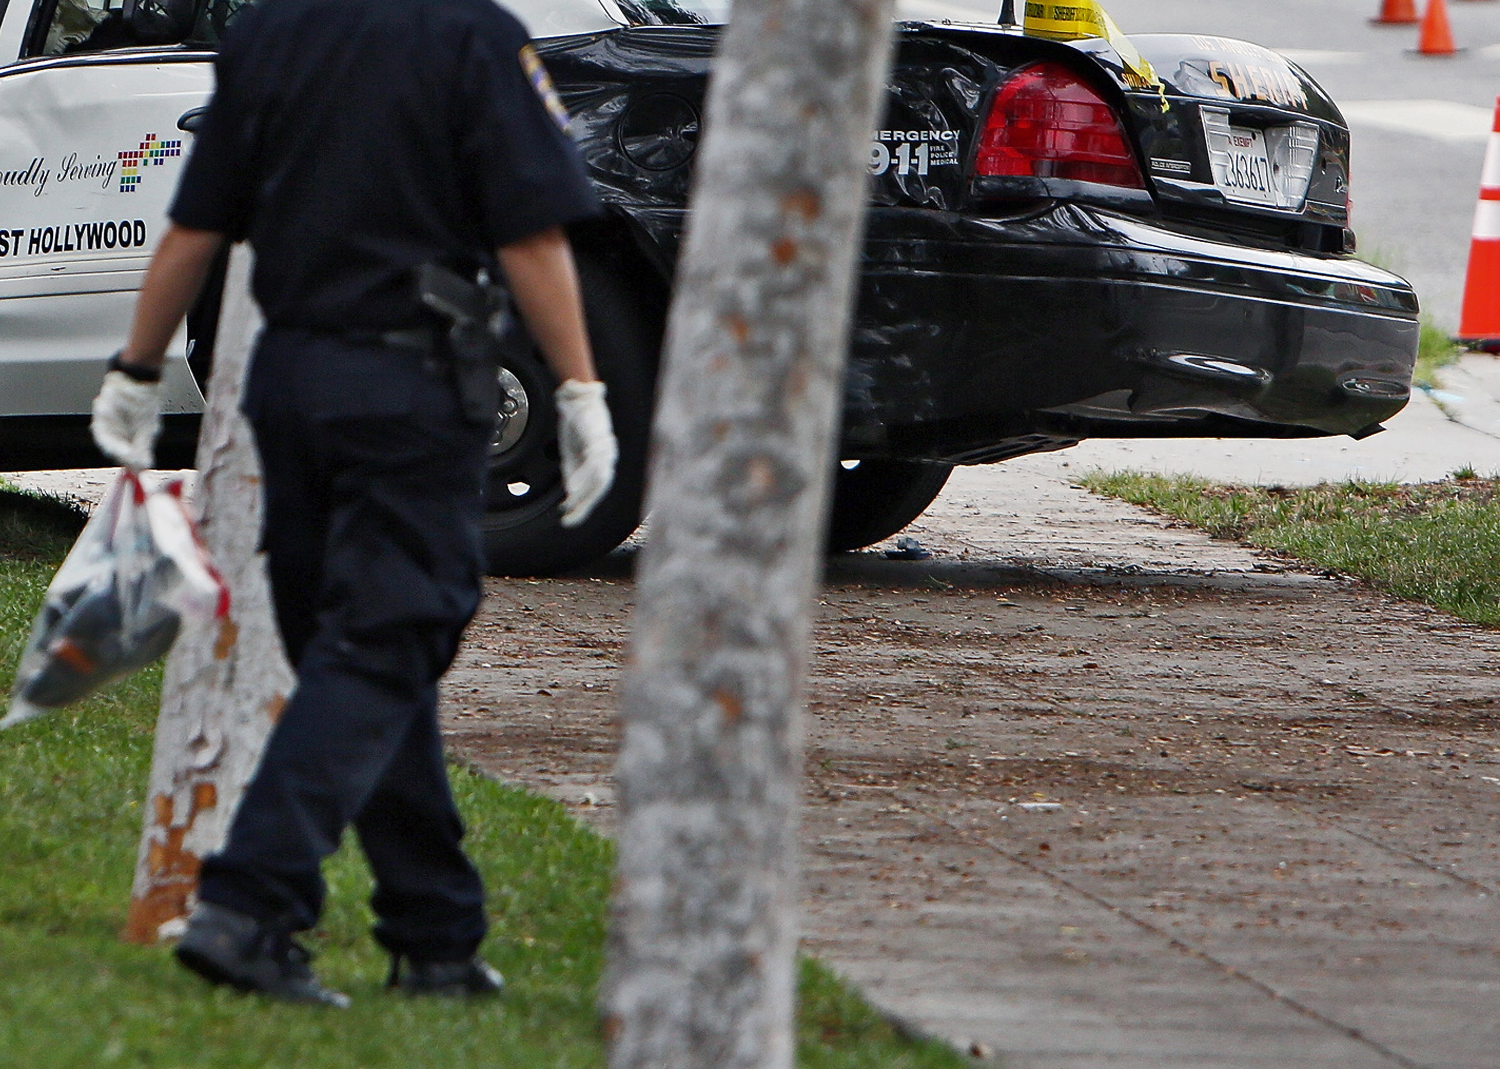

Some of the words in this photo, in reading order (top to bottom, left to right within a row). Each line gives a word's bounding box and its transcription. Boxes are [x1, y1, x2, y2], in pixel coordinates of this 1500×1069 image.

[872, 130, 960, 141] ERGENCY
[56, 151, 119, 188] Serving
[28, 220, 146, 255] HOLLYWOOD
